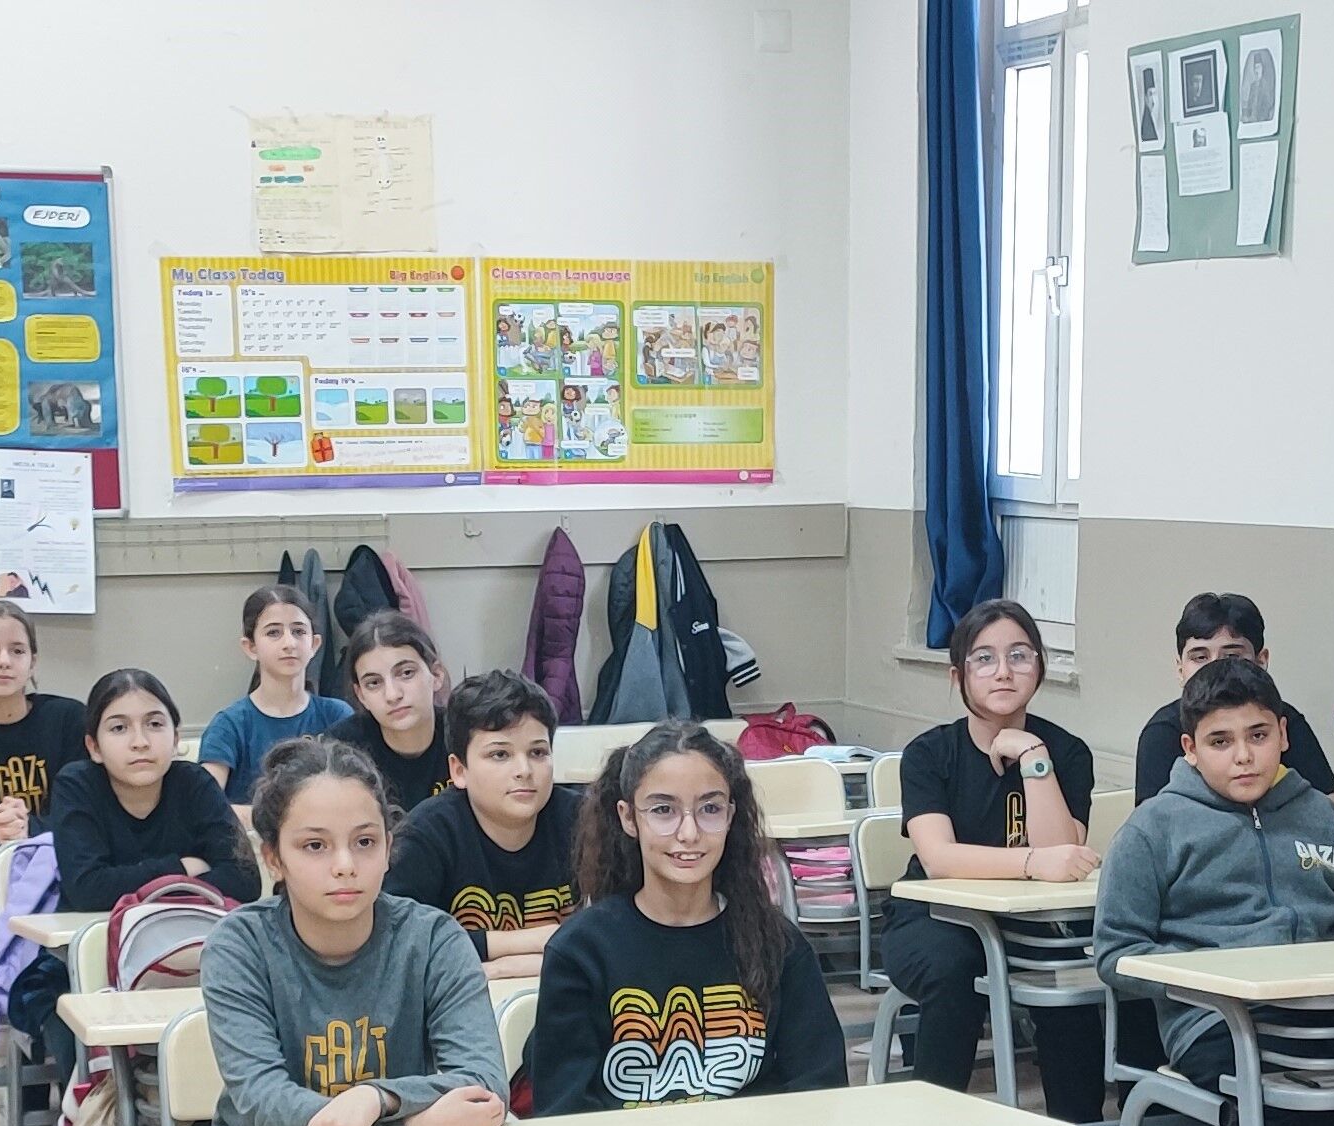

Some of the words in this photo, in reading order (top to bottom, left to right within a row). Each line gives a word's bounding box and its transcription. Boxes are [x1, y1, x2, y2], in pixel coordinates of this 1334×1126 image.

[172, 269, 193, 283] My
[197, 269, 236, 281] Class
[240, 269, 285, 282] Today
[389, 270, 407, 281] Big
[410, 270, 448, 281] English
[492, 267, 562, 280] Classroom
[565, 268, 631, 283] Language
